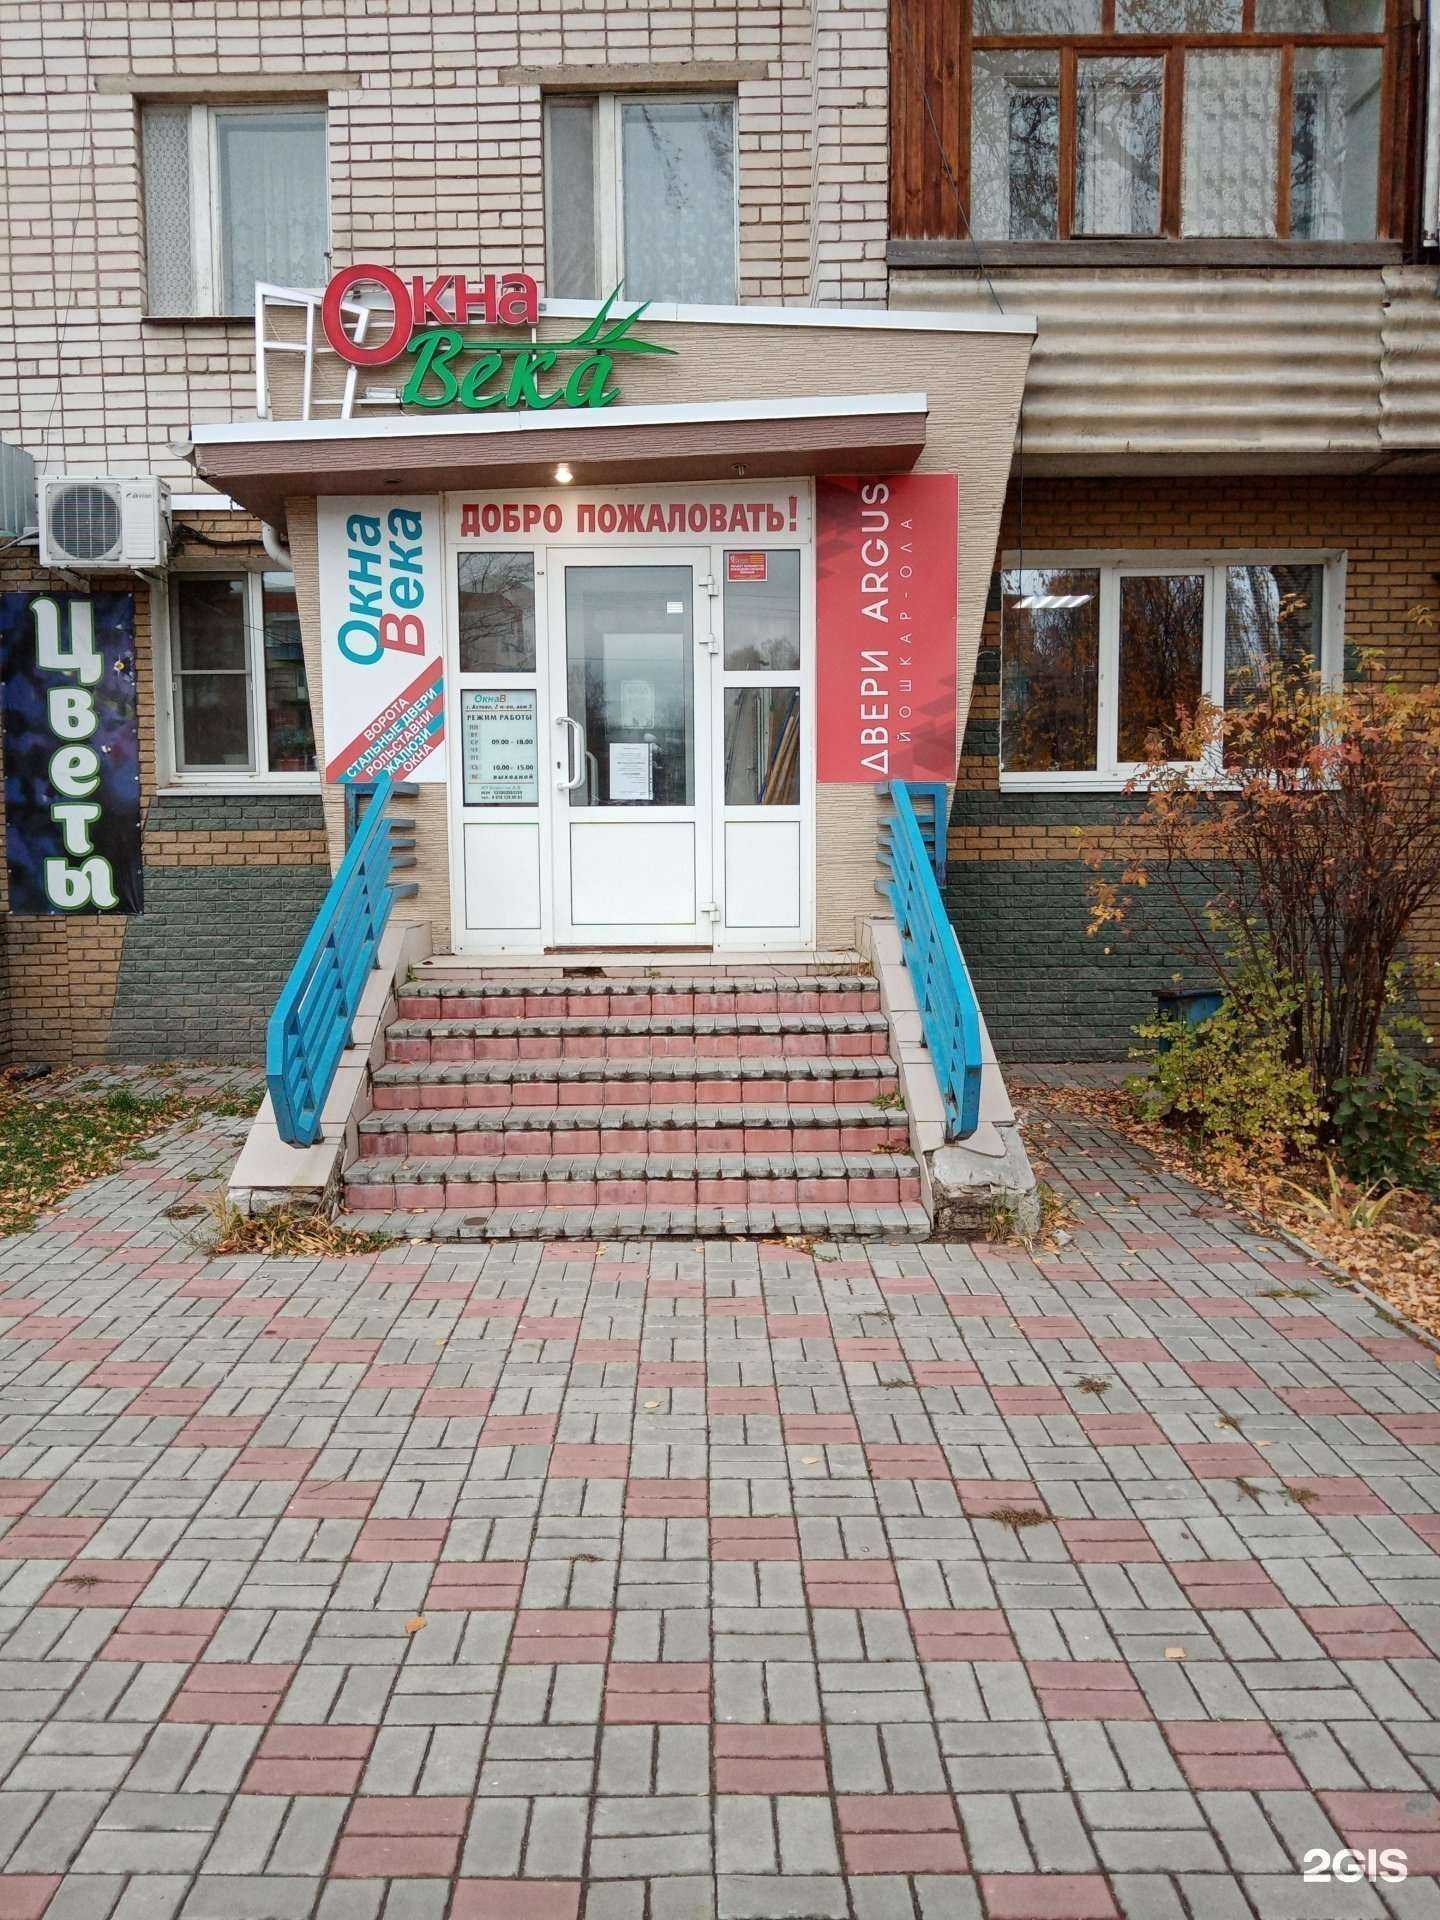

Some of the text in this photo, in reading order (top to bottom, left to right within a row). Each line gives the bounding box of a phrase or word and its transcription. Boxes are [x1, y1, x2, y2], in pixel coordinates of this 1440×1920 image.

[322, 264, 539, 366] Окна
[402, 329, 621, 410] Века
[460, 495, 798, 537] ДОБРО ПОЖАЛОВАТЬ!
[337, 513, 385, 665] Окна
[379, 508, 425, 657] Века
[860, 482, 890, 775] ДВЕРИ ARGUS
[28, 596, 119, 911] Цветы
[346, 687, 437, 777] СТАЛЬНЫЕ ДВЕРИ
[363, 697, 410, 741] ВОРОТА
[365, 709, 434, 776] РОЛЬСТАВНИ
[383, 727, 432, 776] ЖАЛЮЗИ
[403, 743, 434, 772] ОКНА
